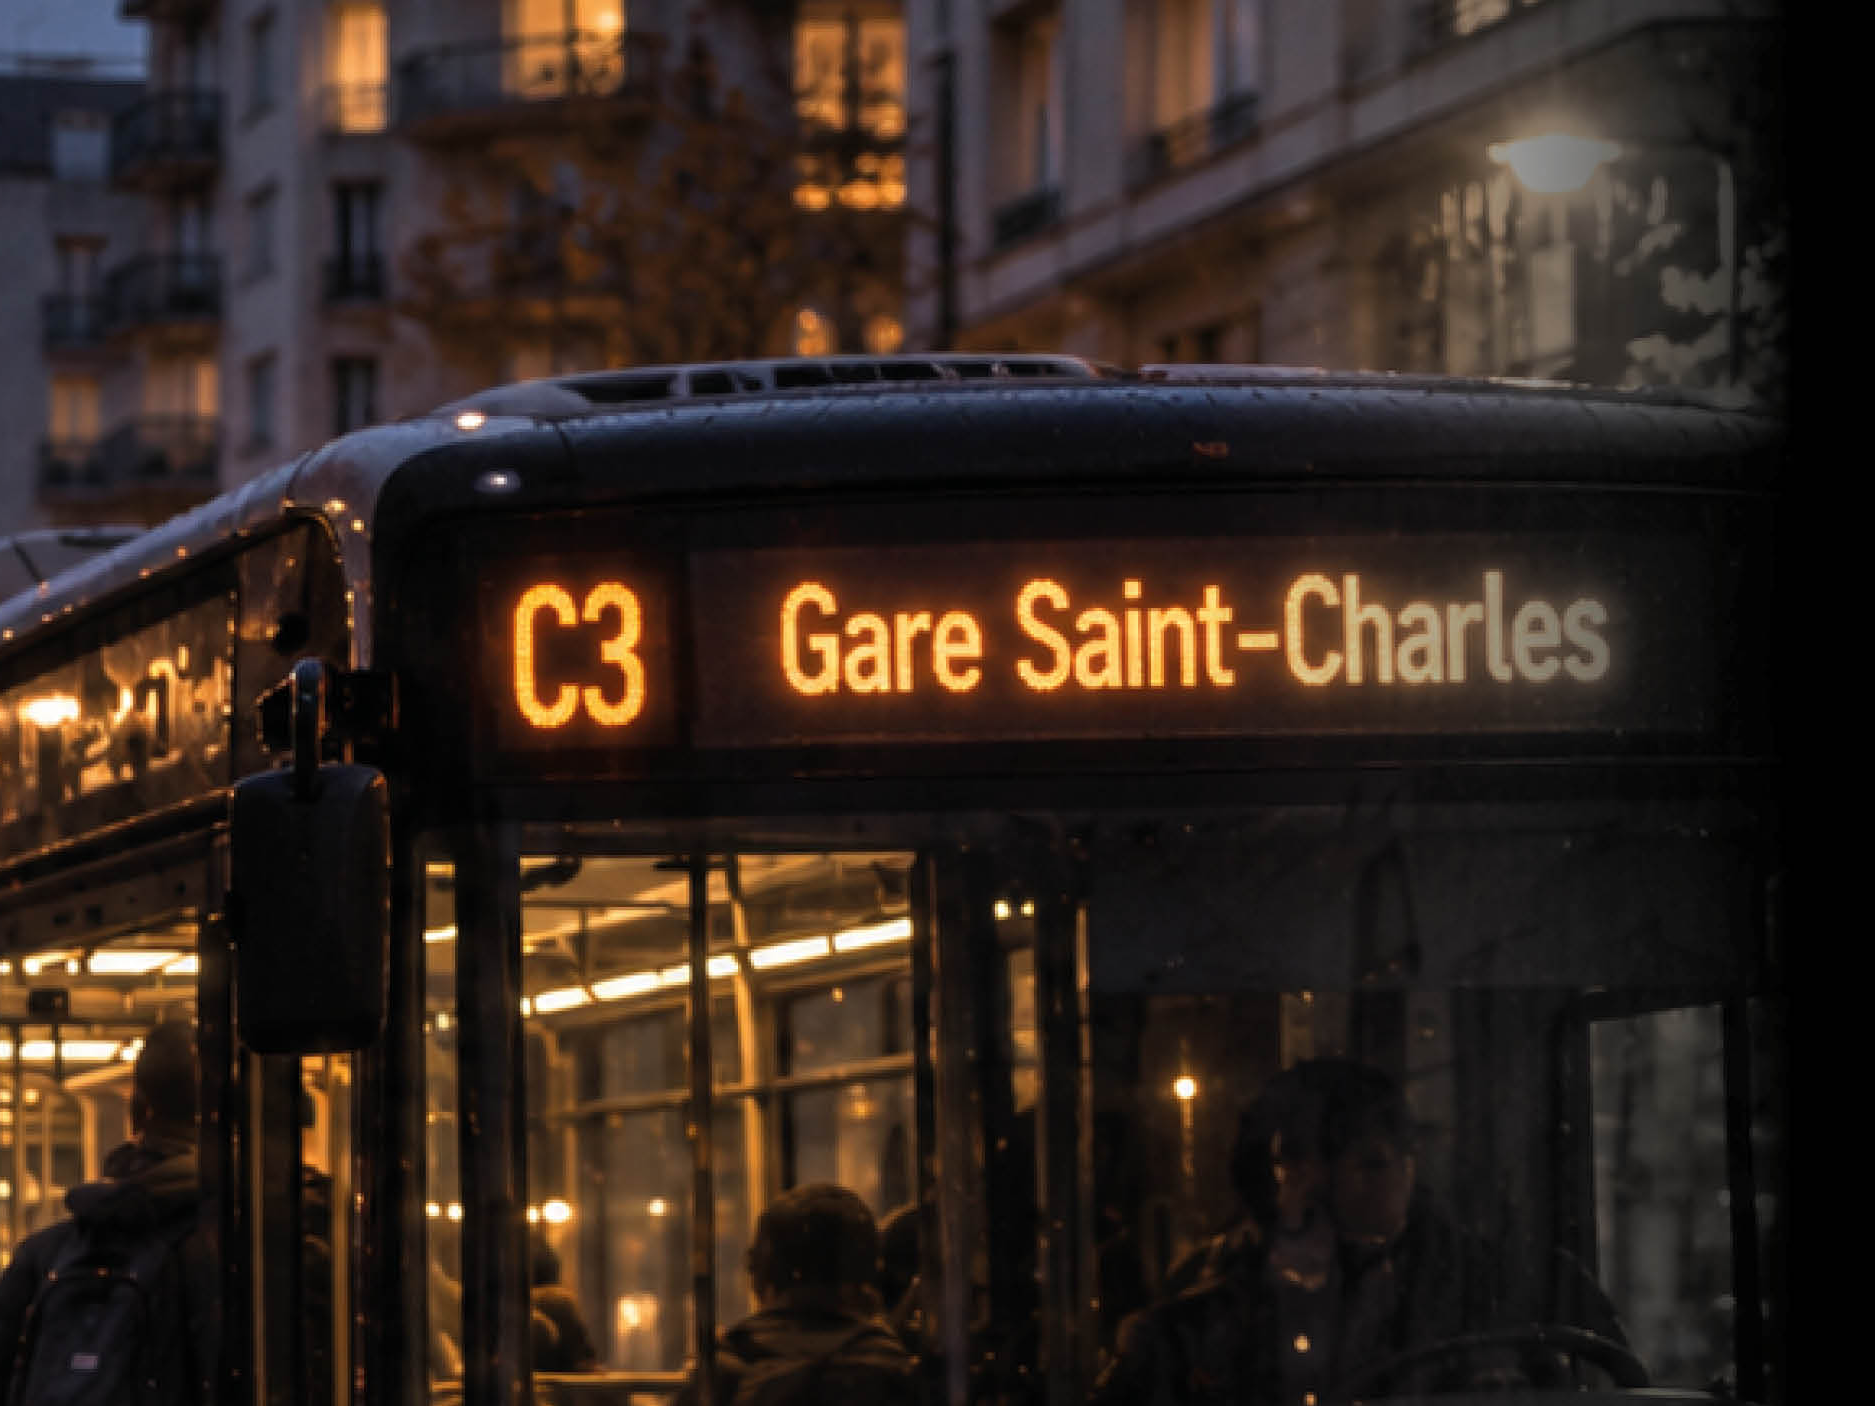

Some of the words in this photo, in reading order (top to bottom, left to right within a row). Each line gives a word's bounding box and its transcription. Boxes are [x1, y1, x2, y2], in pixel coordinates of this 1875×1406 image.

[513, 581, 646, 729] C3
[779, 581, 985, 696] Gare
[1015, 569, 1611, 691] Saint-Charles
